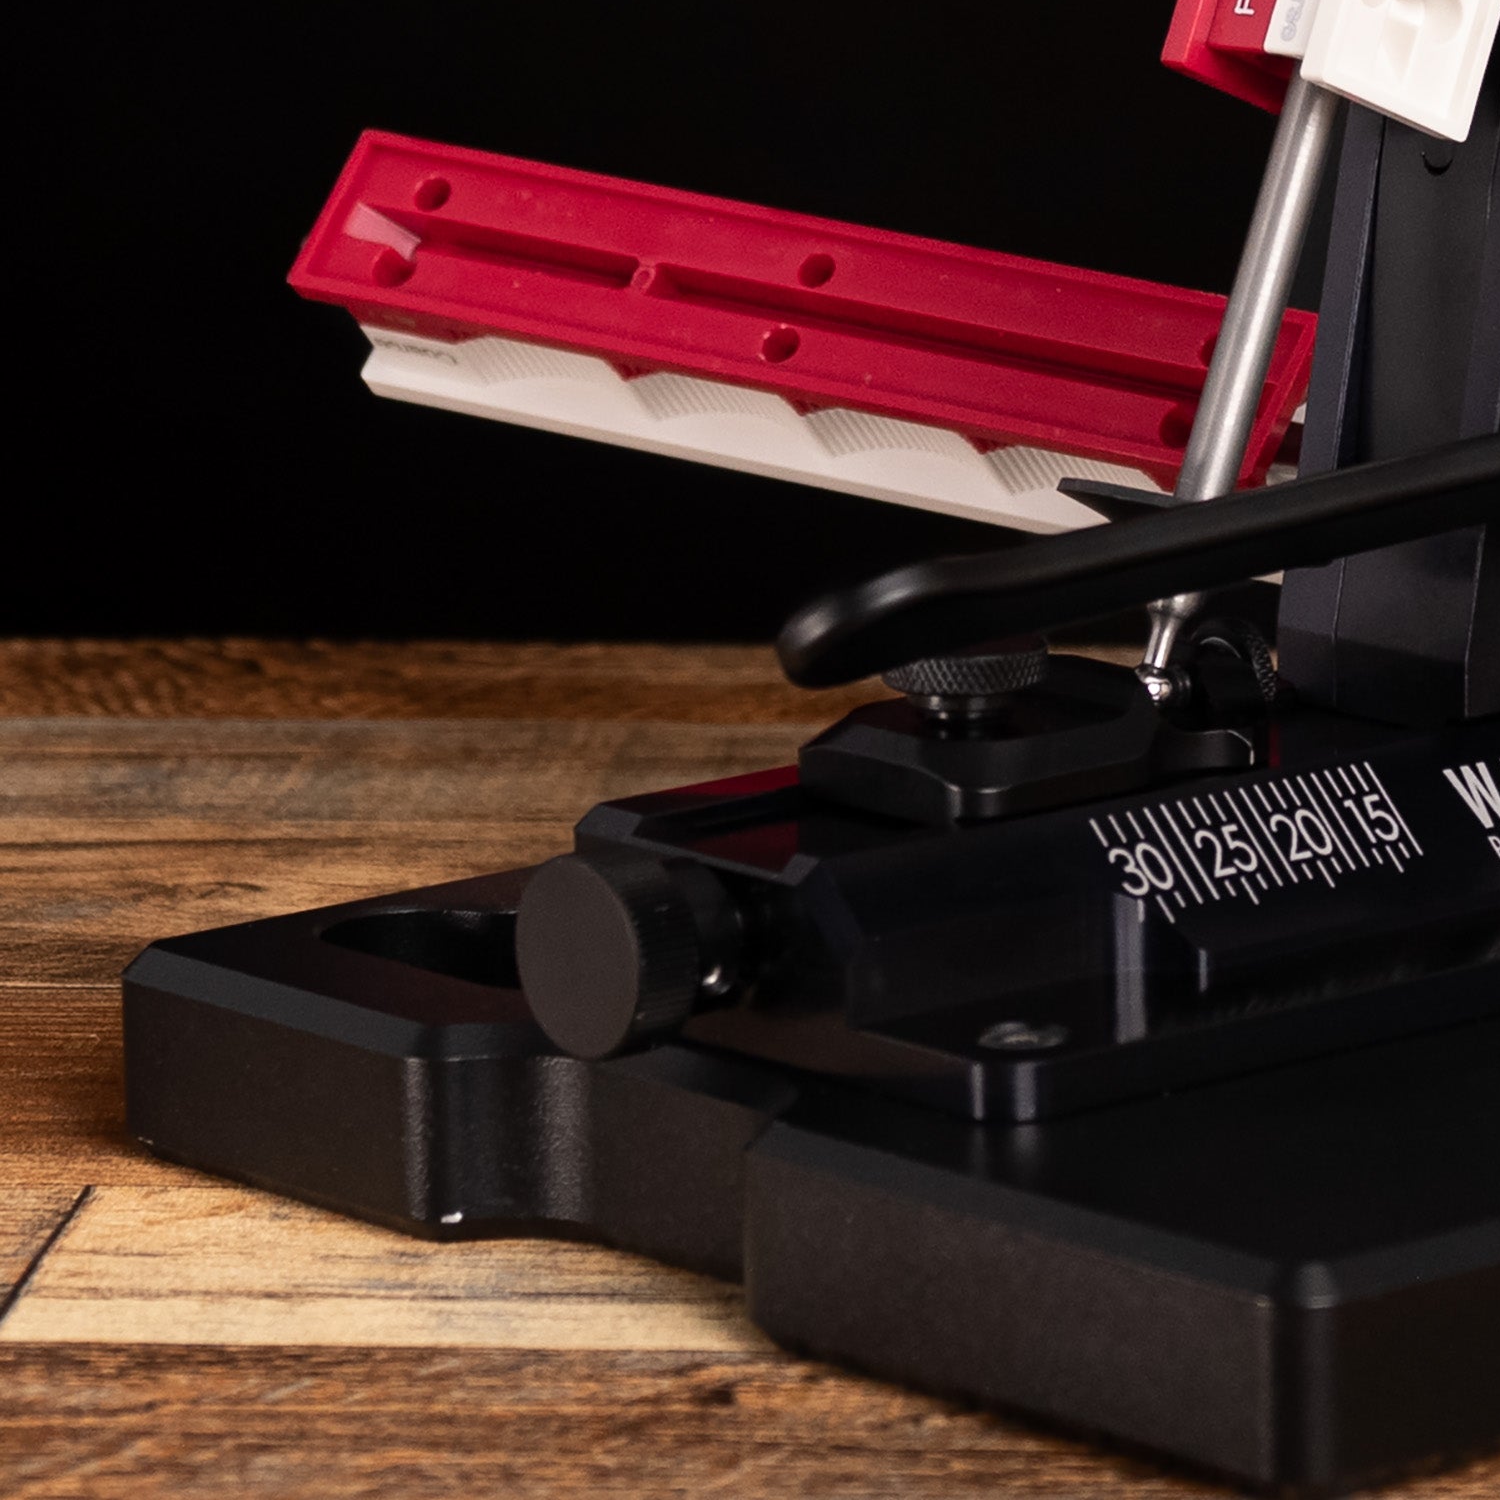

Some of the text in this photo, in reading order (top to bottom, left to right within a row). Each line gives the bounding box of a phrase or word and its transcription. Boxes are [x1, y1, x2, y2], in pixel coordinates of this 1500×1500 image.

[1108, 794, 1399, 896] 30 25 20 15
